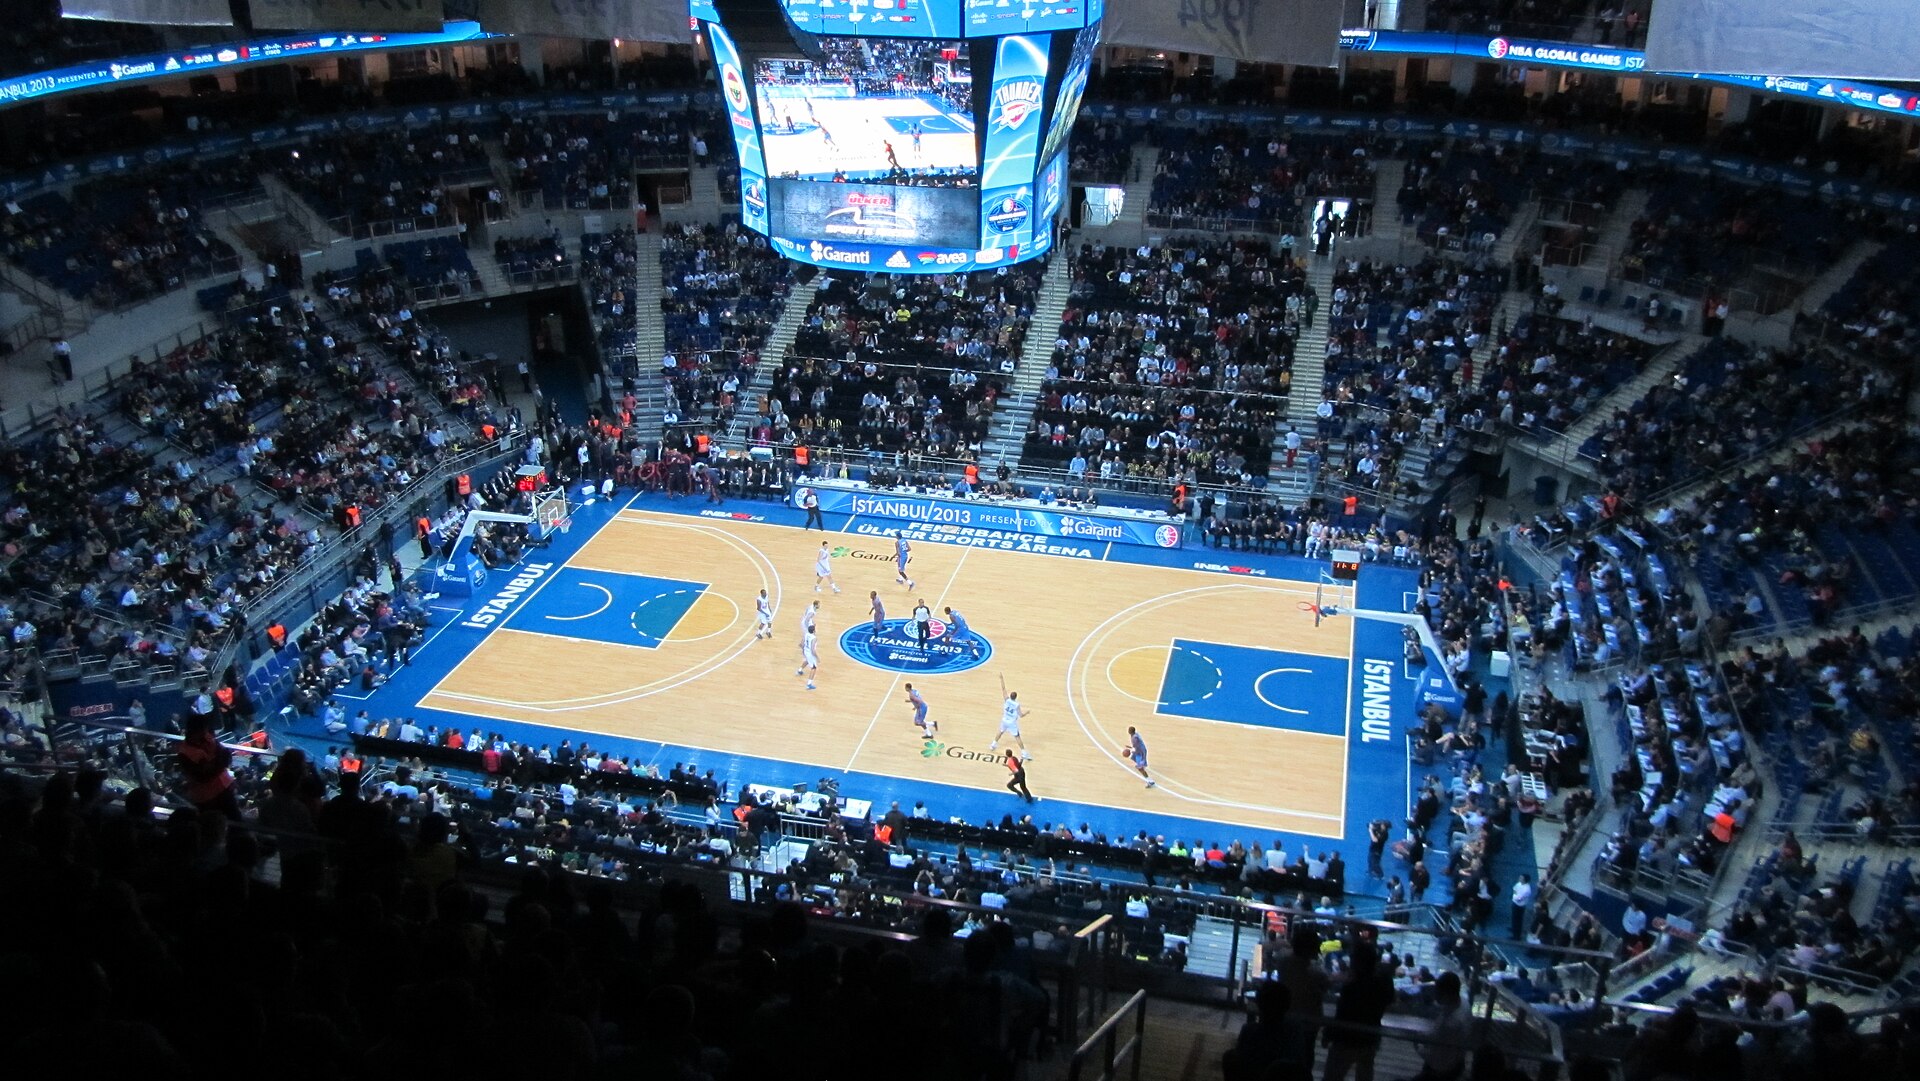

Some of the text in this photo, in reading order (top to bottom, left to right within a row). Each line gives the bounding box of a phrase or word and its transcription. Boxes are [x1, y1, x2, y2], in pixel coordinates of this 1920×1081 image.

[195, 53, 214, 64] avea
[1508, 45, 1533, 58] NBA
[1535, 47, 1578, 62] GLOBAL
[1580, 51, 1621, 66] GAMES
[30, 76, 55, 93] 2013
[57, 71, 96, 84] PRESENTED
[122, 62, 155, 76] Garanti
[1775, 76, 1809, 92] Garanti
[1851, 90, 1873, 101] avea
[995, 81, 1042, 106] THUNDER
[796, 243, 805, 253] BY
[823, 246, 870, 264] Garanti
[936, 252, 967, 264] avea
[851, 496, 1122, 538] İSTANBUL 2013 PRESENTED BY Garanti
[857, 523, 1092, 558] ÜLKER SPORTS ARENA
[908, 522, 1048, 544] FENRBAHÇE
[851, 550, 912, 564] Garani
[461, 562, 553, 628] İSTANBUL
[898, 654, 928, 663] Garanti
[1362, 658, 1395, 743] İSTANBUL
[946, 746, 1008, 765] Garan
